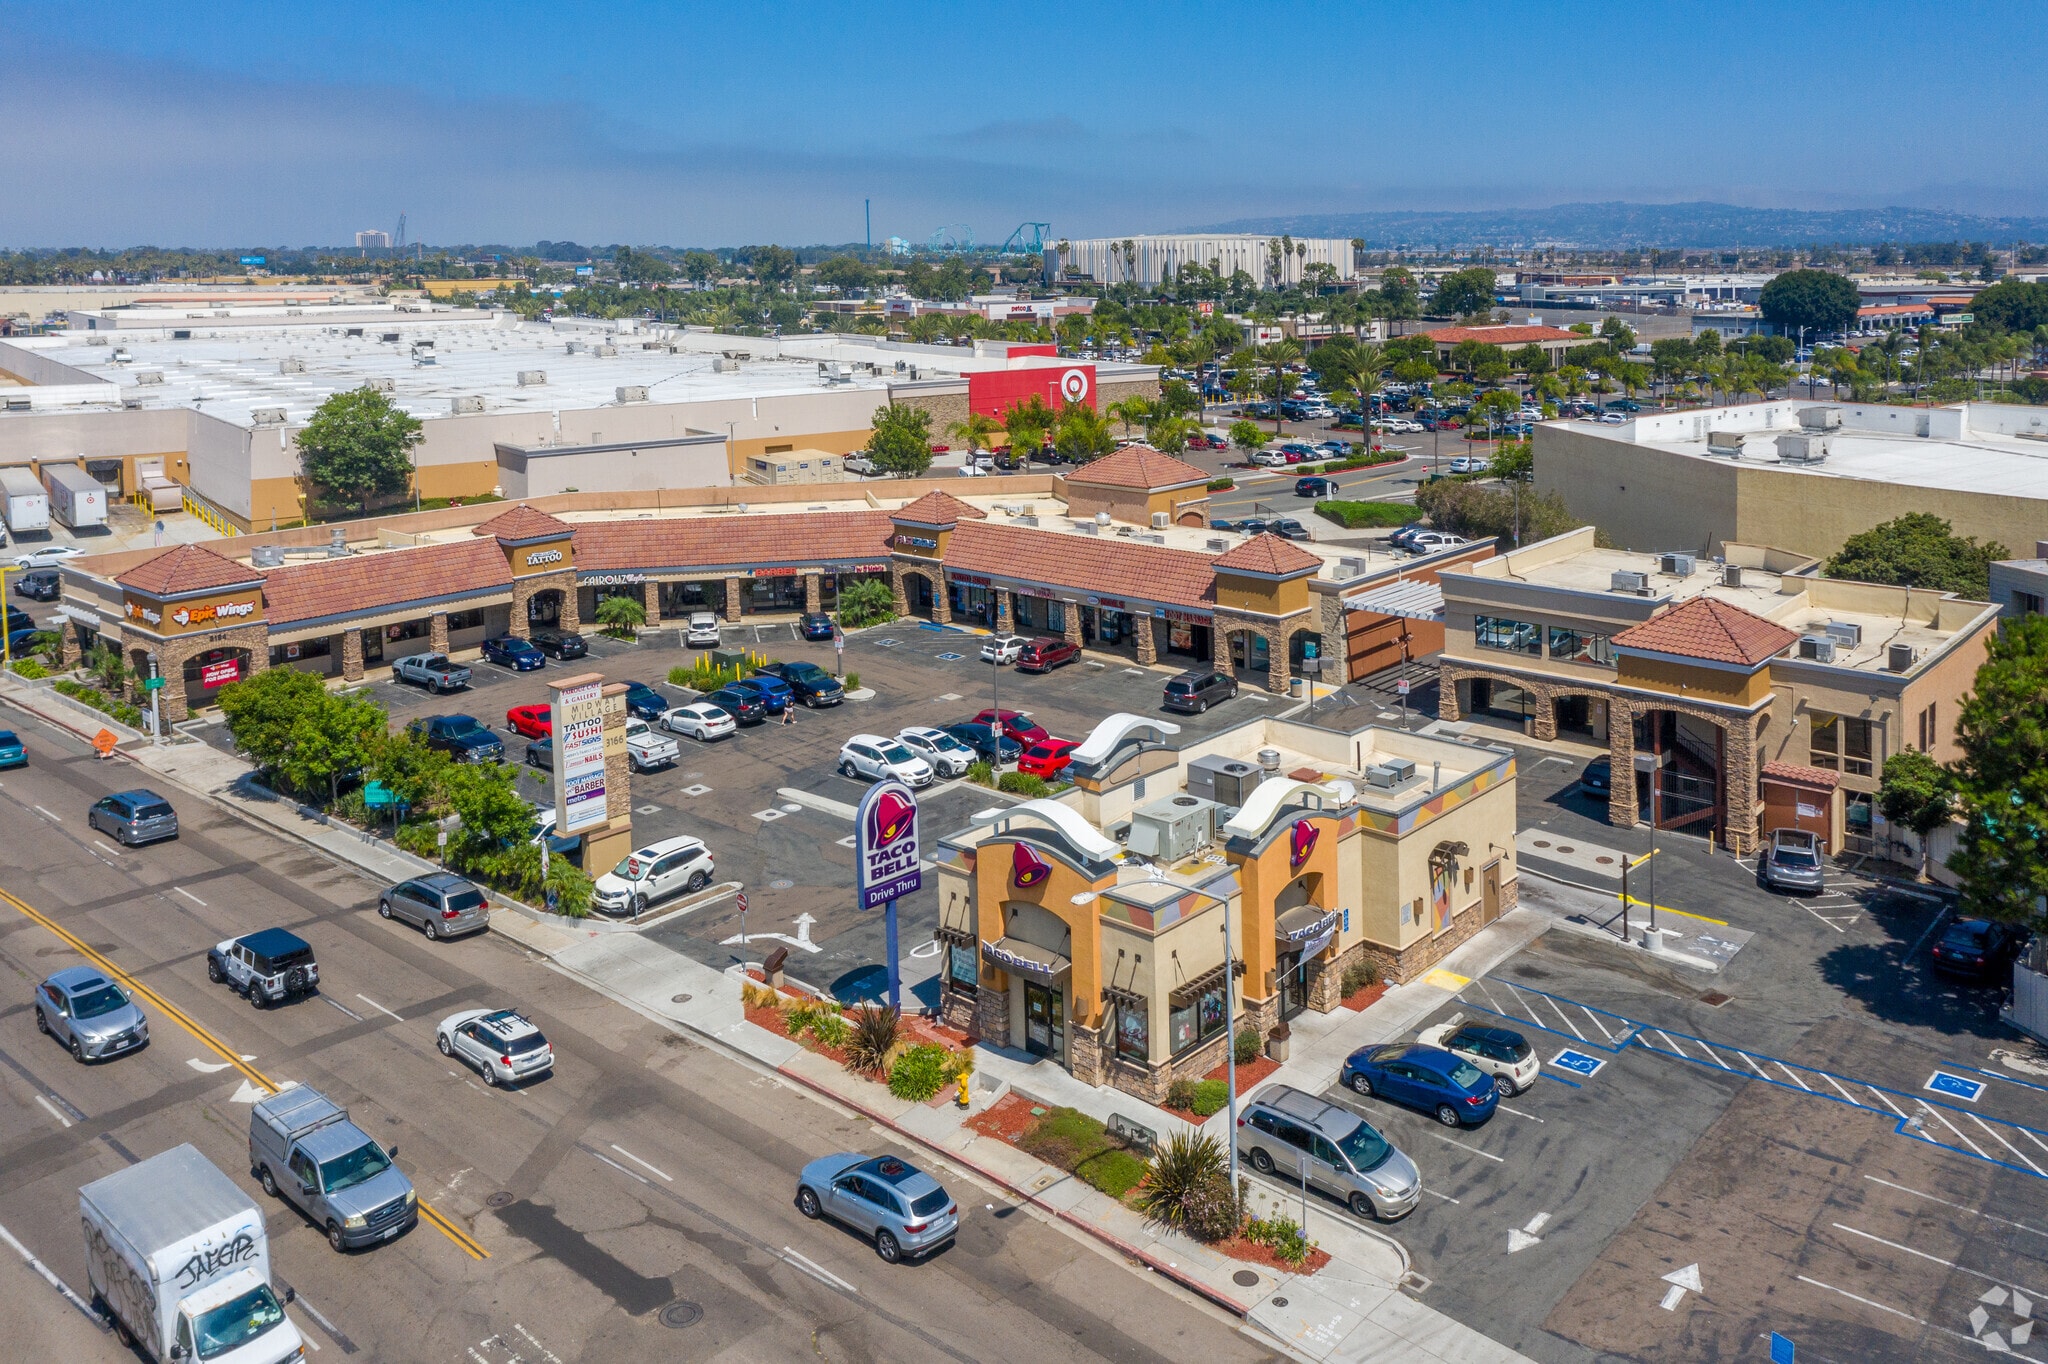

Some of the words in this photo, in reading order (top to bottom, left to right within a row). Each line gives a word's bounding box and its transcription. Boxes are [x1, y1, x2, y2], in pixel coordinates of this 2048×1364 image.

[1011, 304, 1026, 312] petco
[526, 552, 562, 565] TATTOO
[755, 567, 797, 577] BARBER
[584, 574, 627, 586] FAIROUZ
[206, 670, 220, 678] NOW
[220, 666, 236, 675] OPEN
[571, 692, 597, 702] GALLERY
[571, 697, 616, 714] MIDWAY
[571, 703, 617, 721] VILLAGE
[564, 717, 601, 732] TATTOO
[572, 726, 603, 740] SUSHI
[564, 735, 602, 751] FASTSIGNS
[606, 735, 624, 748] 3166
[584, 753, 603, 764] NAILS
[567, 778, 580, 787] FOOT
[574, 779, 605, 794] BARBER
[567, 794, 587, 804] metro
[867, 840, 916, 867] TACO
[870, 855, 918, 881] BELL
[870, 887, 895, 903] Drive
[896, 878, 917, 893] Thru
[1288, 921, 1321, 940] TACO
[981, 939, 1012, 964] TACO
[1012, 957, 1055, 975] BELL
